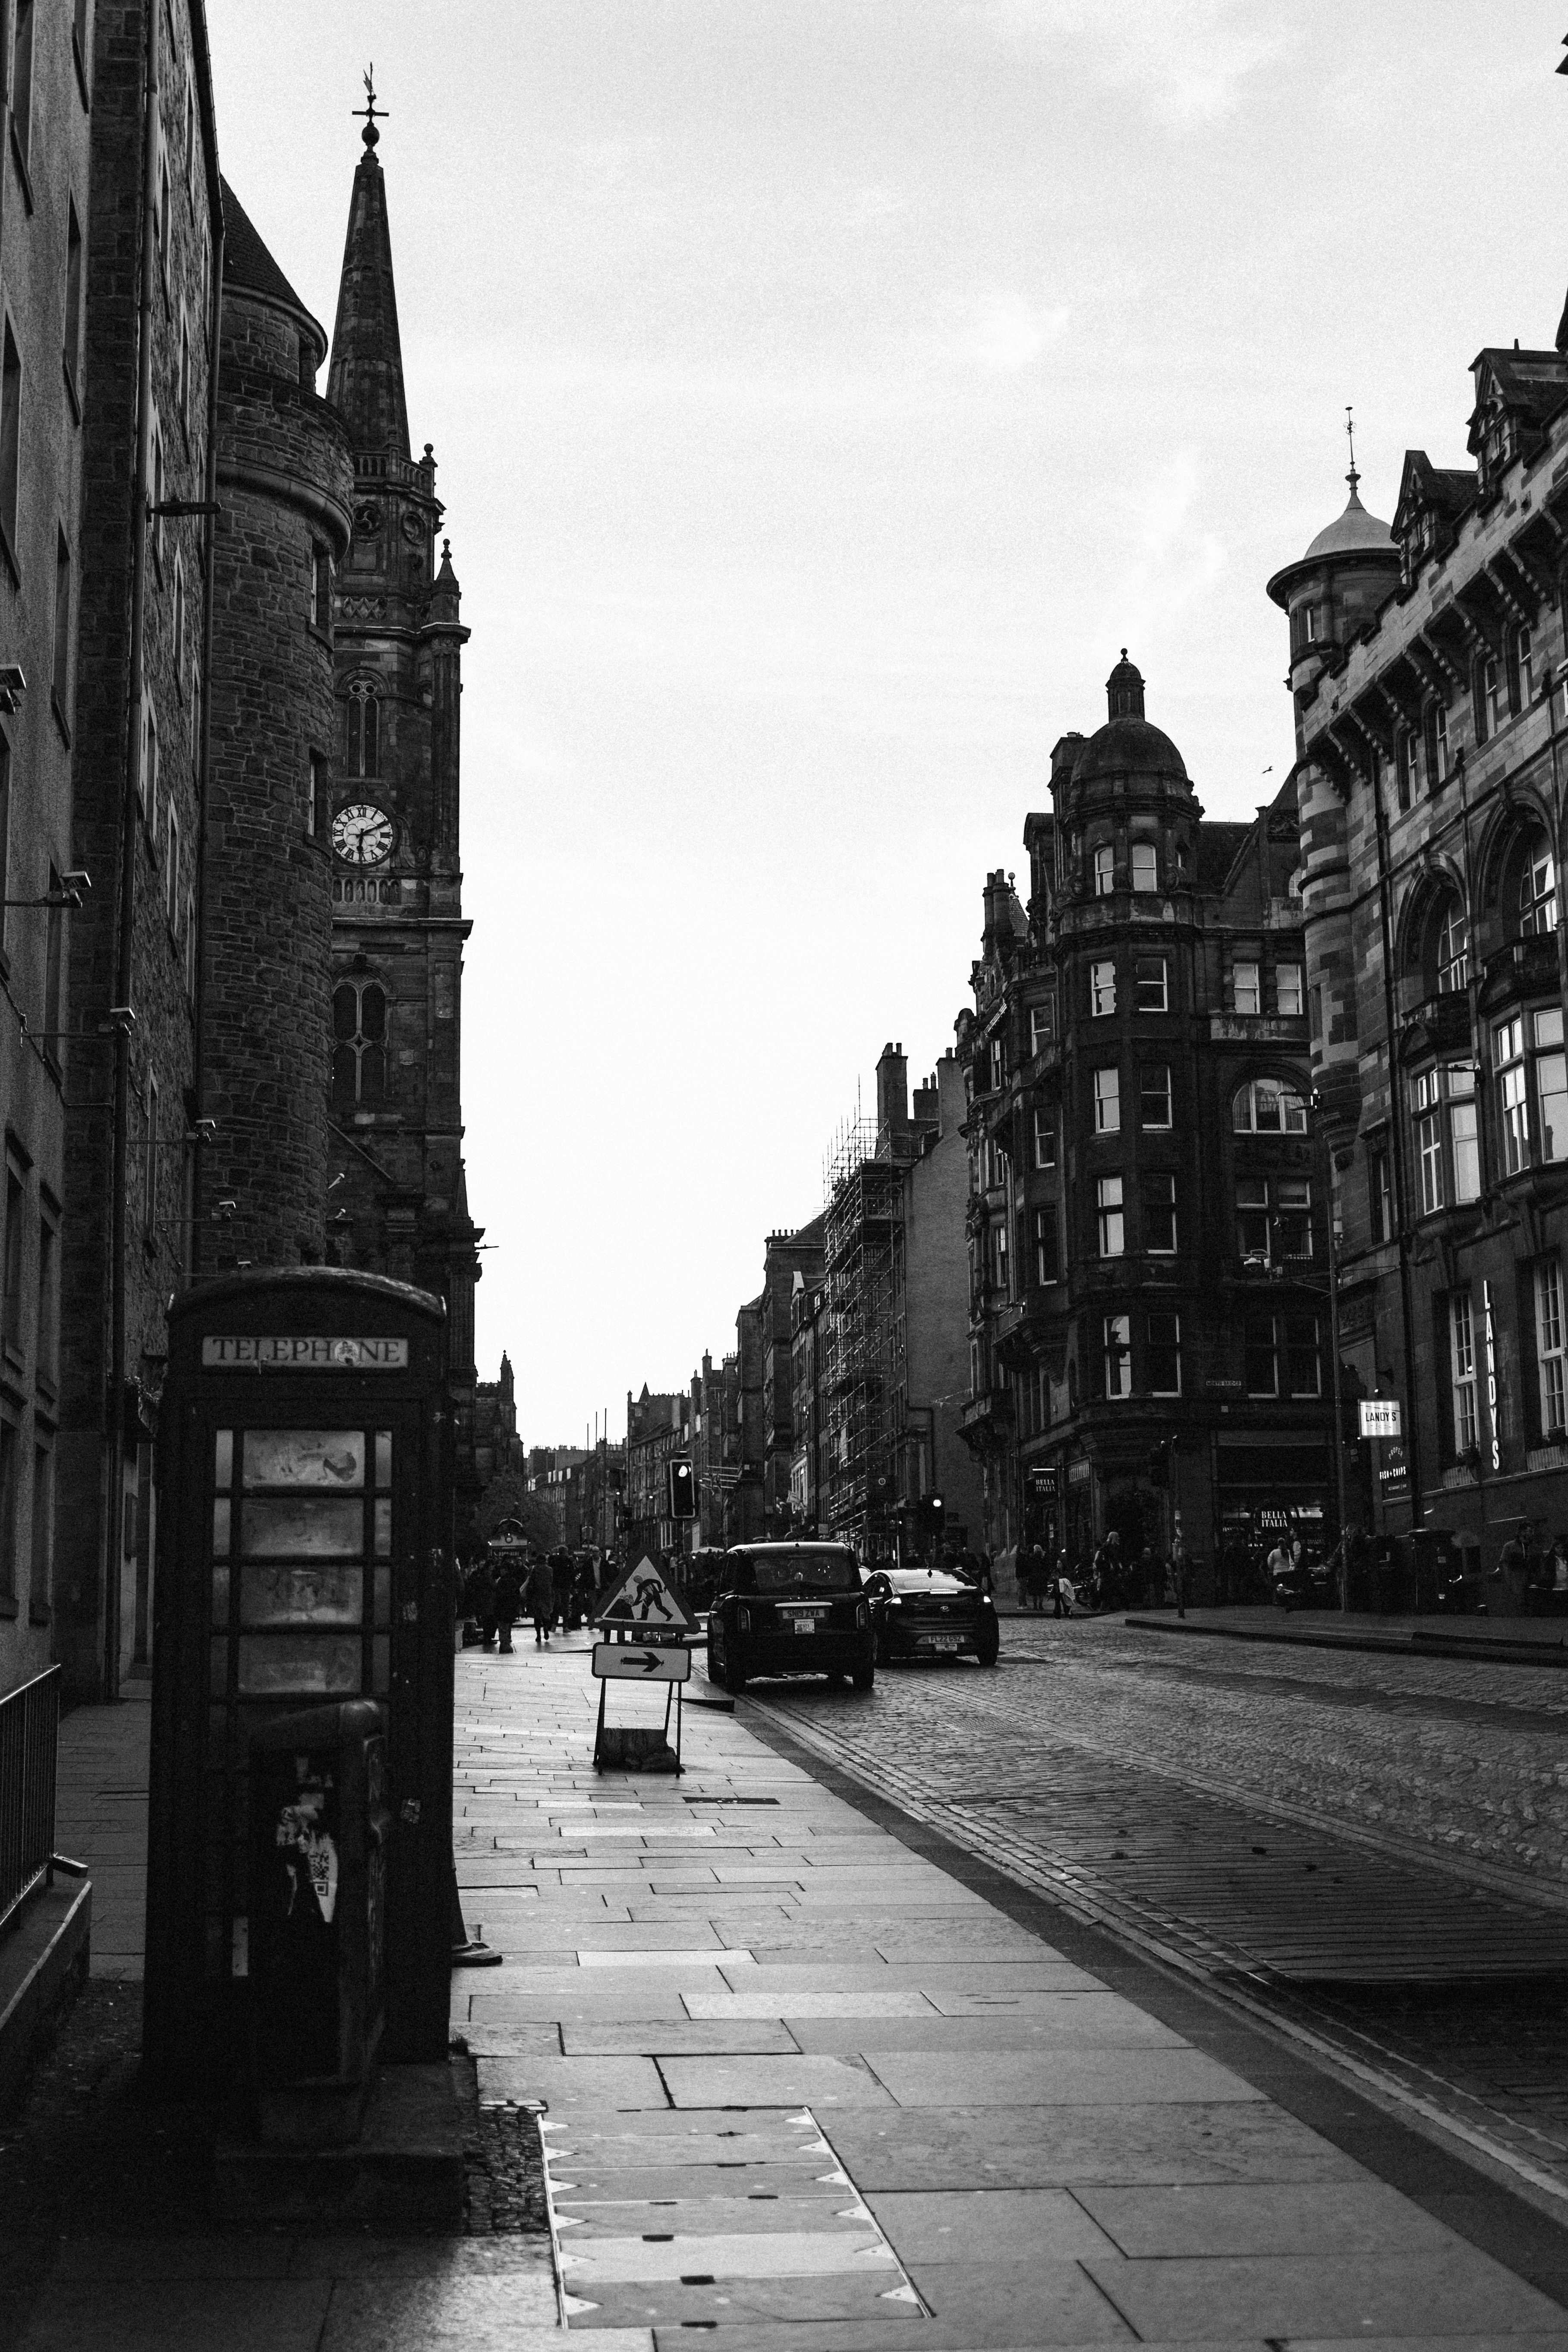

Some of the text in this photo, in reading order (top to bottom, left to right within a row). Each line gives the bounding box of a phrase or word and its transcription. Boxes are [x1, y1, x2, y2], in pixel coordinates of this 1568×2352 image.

[357, 807, 366, 817] XII
[212, 1339, 400, 1363] TELEPHNE
[1484, 1280, 1499, 1469] LANDYS
[787, 1609, 803, 1618] SN19
